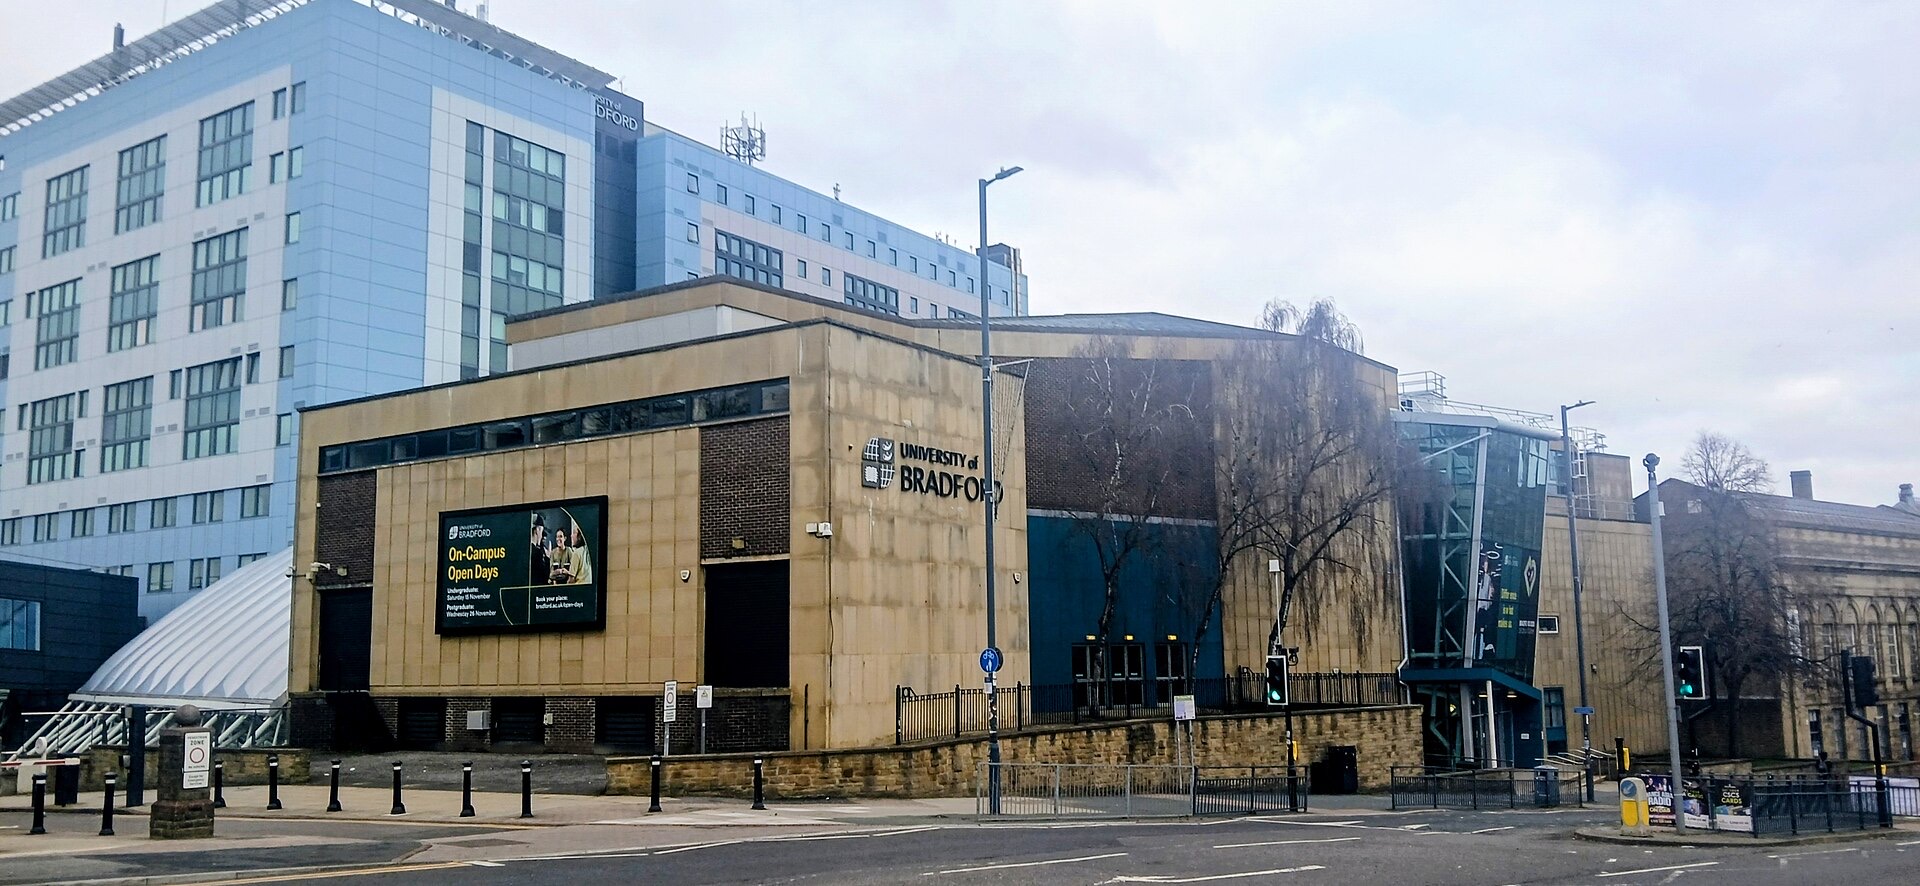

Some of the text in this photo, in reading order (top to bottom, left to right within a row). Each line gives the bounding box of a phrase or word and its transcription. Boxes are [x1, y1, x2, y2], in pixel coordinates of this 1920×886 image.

[900, 442, 979, 470] UNIVERSITY of
[459, 529, 491, 539] BRADFORD
[448, 545, 506, 562] On-Campus
[448, 564, 499, 583] Open Days
[1648, 797, 1672, 806] RADIO
